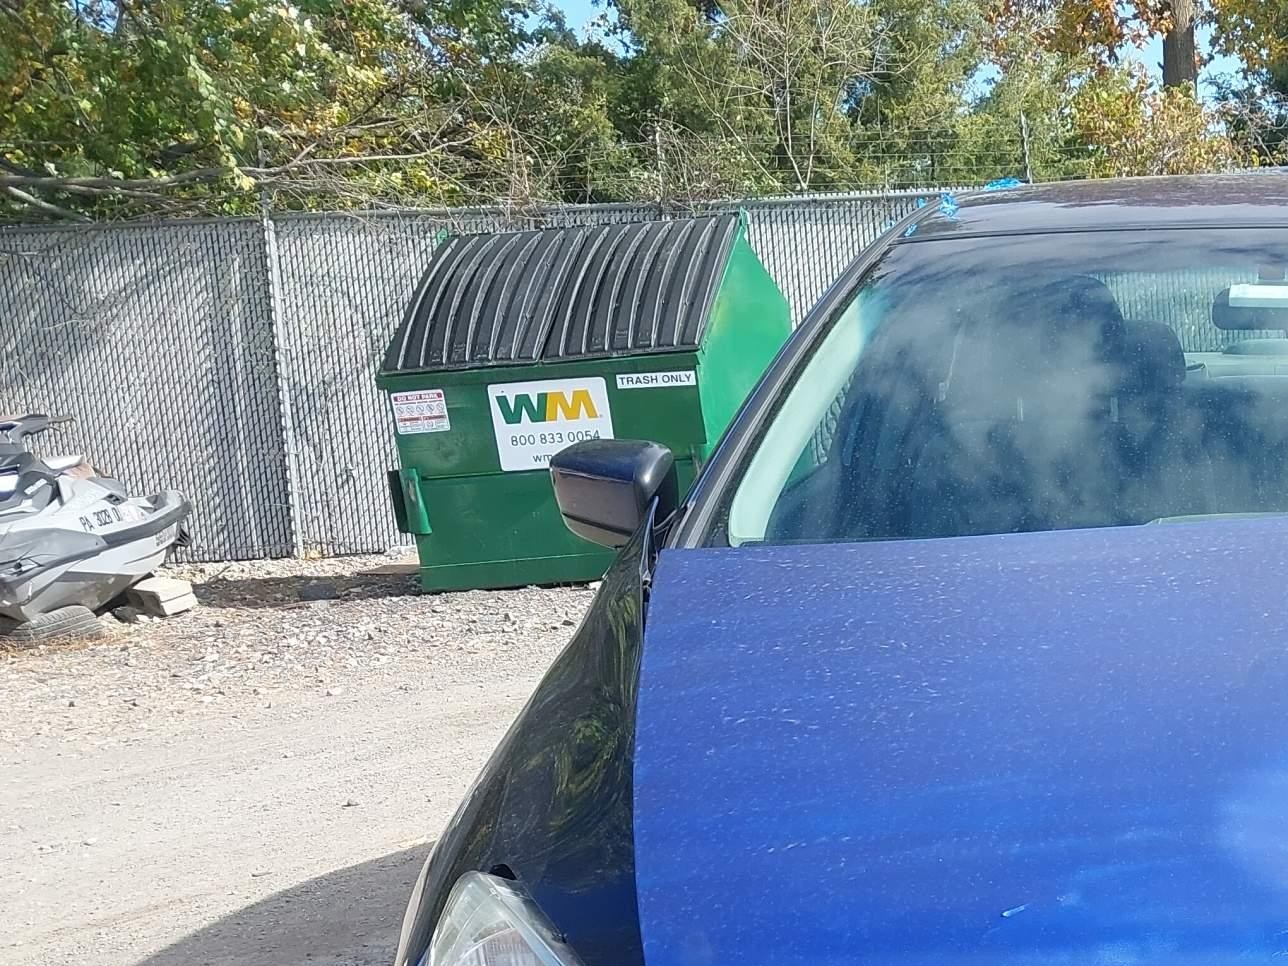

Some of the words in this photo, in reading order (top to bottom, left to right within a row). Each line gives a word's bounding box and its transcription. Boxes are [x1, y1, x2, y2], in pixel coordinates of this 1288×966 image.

[618, 375, 659, 386] TRASH
[661, 373, 692, 384] ONLY
[495, 389, 600, 425] WM
[510, 434, 536, 447] 800
[540, 431, 564, 445] 833
[567, 429, 601, 443] 0054
[79, 515, 95, 532] PA
